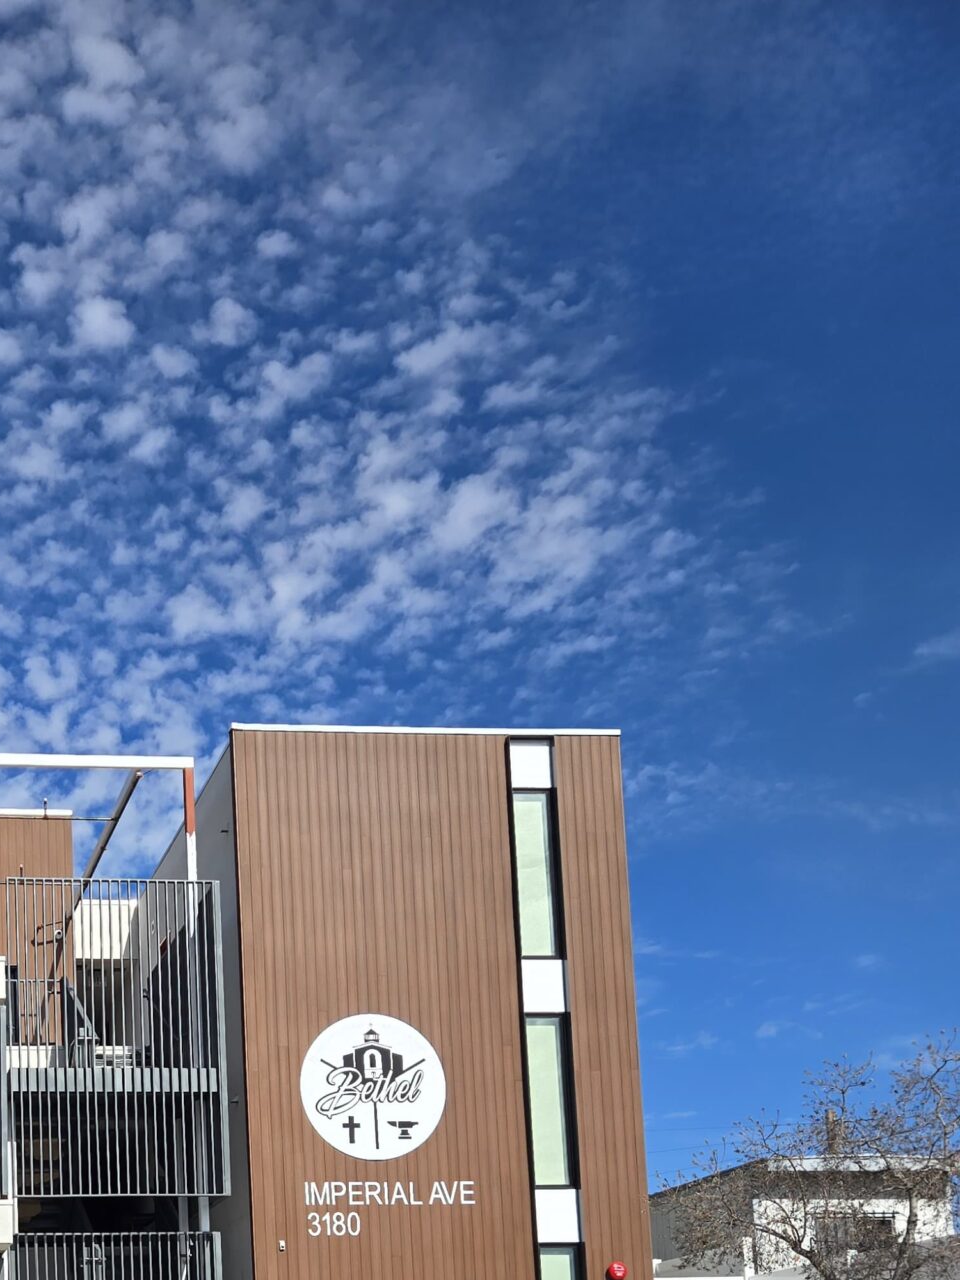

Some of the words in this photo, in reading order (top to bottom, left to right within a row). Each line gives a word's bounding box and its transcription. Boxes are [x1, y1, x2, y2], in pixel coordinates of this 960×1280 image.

[316, 1066, 424, 1119] Bethel
[304, 1181, 423, 1206] IMPERIAL
[428, 1180, 476, 1205] AVE
[307, 1211, 361, 1236] 3180
